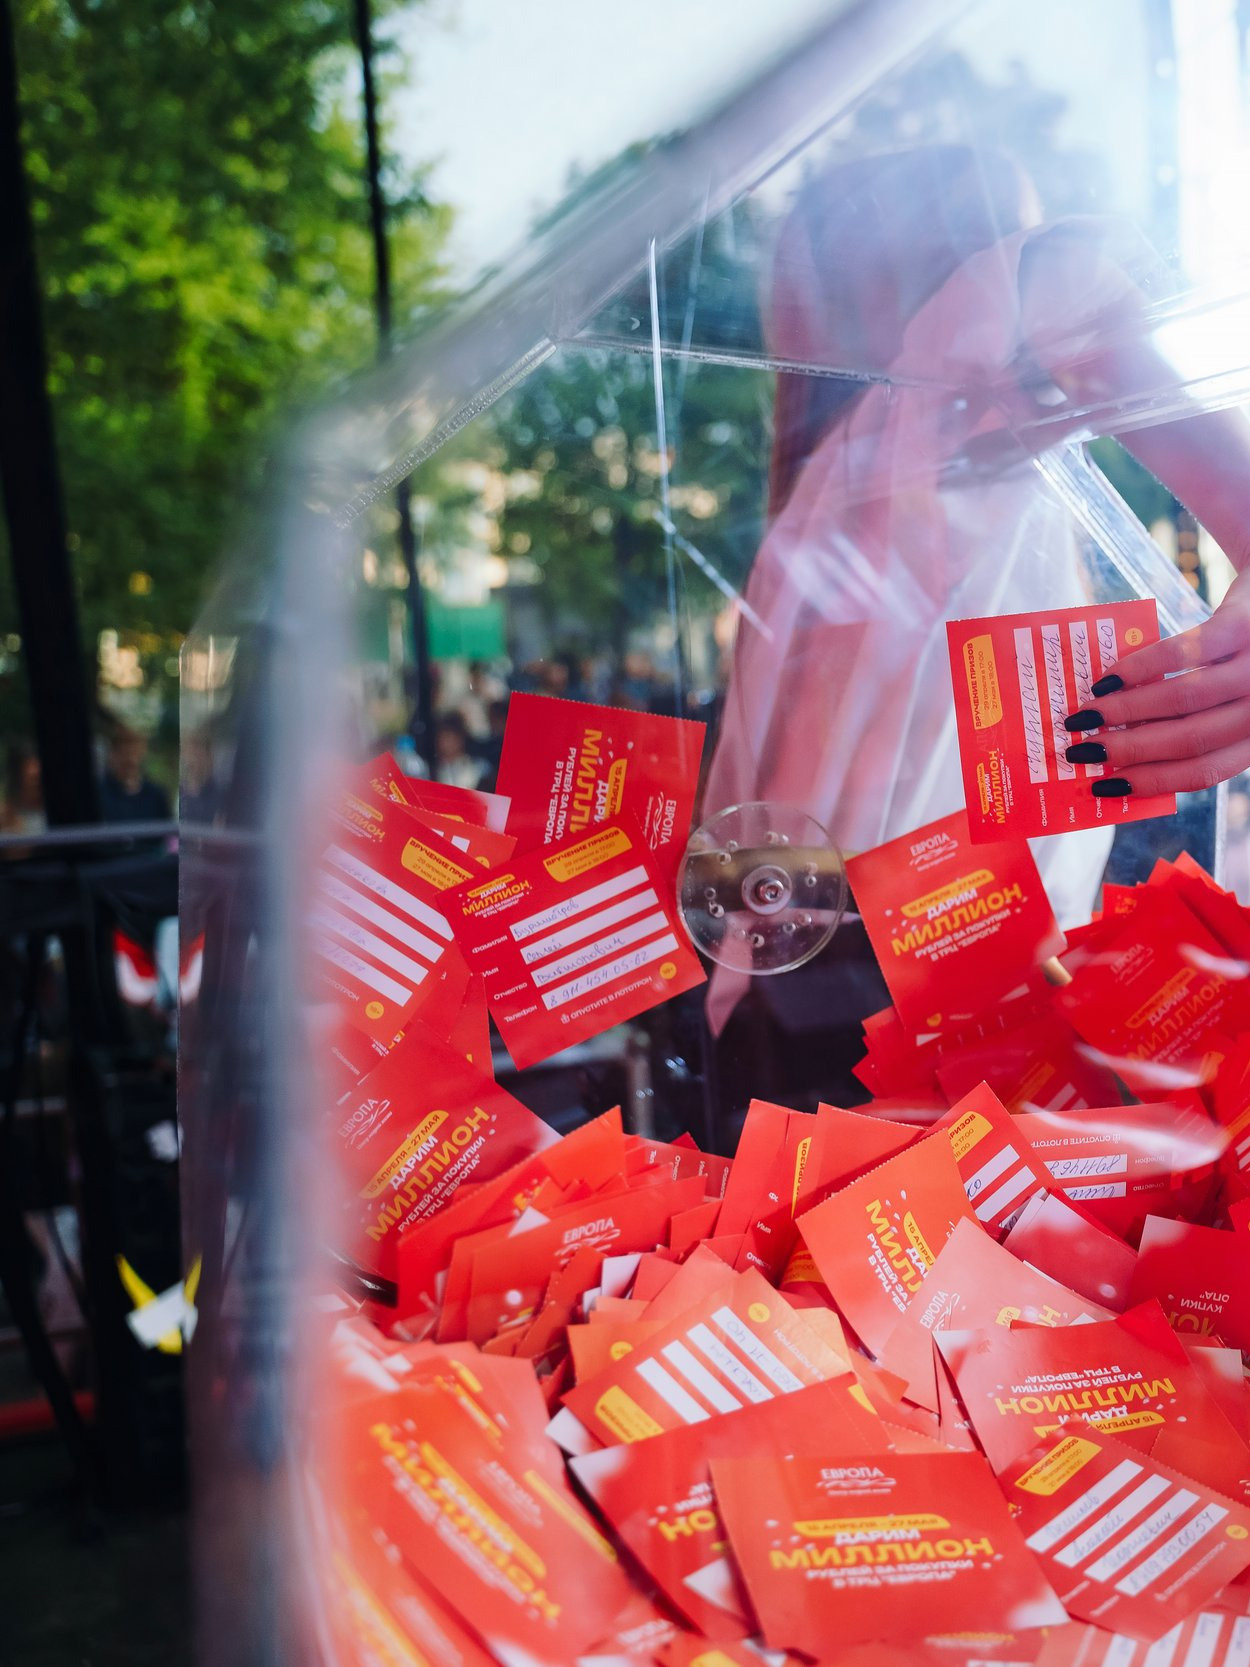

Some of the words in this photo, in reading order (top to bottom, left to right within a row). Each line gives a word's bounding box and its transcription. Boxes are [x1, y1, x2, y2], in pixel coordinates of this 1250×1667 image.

[966, 642, 976, 678] ПРИЗОВ
[970, 679, 983, 727] ВРУЧЕНИЕ
[550, 769, 562, 793] ТРЦ
[561, 746, 578, 792] РУБЛЕЙ
[559, 793, 569, 808] ЗА
[984, 773, 993, 802] ДАРИМ
[989, 750, 1006, 823] МИЛЛИОН
[658, 799, 677, 845] ЕВРОПА
[1037, 788, 1048, 826] Фамилия
[408, 838, 450, 869] ВРУЧЕНИЕ
[545, 843, 589, 867] ВРУЧЕНИЕ
[588, 828, 620, 847] ПРИЗОВ
[908, 830, 950, 857] ЕВРОПА
[461, 879, 530, 917] МИЛЛИОН
[923, 886, 979, 921] ДАРИМ
[889, 881, 1024, 957] МИЛЛИОН
[471, 933, 508, 956] Фамилия
[914, 934, 954, 958] РУБЛЕЙ
[929, 951, 939, 962] В
[937, 942, 959, 958] ТРЦ
[481, 965, 499, 979] Имя
[493, 980, 528, 1001] Отчество
[569, 995, 610, 1020] ОПУСТИТЕ
[612, 974, 653, 999] ЛОТОТРОН
[503, 1003, 538, 1024] Телефон
[1145, 986, 1193, 1026] ДАРИМ
[337, 1093, 379, 1140] ЕВРОПА
[946, 1113, 976, 1140] РИЗОВ
[375, 1148, 408, 1186] АПРЕЛЯ
[410, 1133, 422, 1147] 27
[419, 1112, 441, 1137] МАЯ
[1069, 1133, 1110, 1144] ОПУСТИТЕ
[363, 1101, 490, 1246] МИЛЛИОН
[387, 1132, 439, 1191] ДАРИМ
[396, 1191, 434, 1234] РУБЛЕЙ
[430, 1179, 446, 1196] ЗА
[441, 1133, 486, 1184] ПОКУПКИ
[423, 1197, 444, 1220] ТРЦ
[560, 1216, 616, 1244] ЕВРОПА
[865, 1232, 899, 1284] РУБЛЕЙ
[894, 1282, 908, 1301] ЗА
[866, 1254, 877, 1266] В
[872, 1264, 892, 1293] ТРЦ
[915, 1288, 954, 1329] ЕВРОПА
[1180, 1297, 1222, 1313] КУПКИ
[1072, 1378, 1089, 1388] ЗА
[1083, 1365, 1109, 1377] ТРЦ
[1091, 1370, 1142, 1386] РУБЛЕЙ
[1111, 1364, 1120, 1373] В
[994, 1373, 1176, 1420] МИЛЛИОН
[1010, 1377, 1071, 1396] ПОКУПКИ
[1095, 1416, 1140, 1431] АПРЕЛЯ
[820, 1464, 884, 1481] ЕВРОПА
[834, 1527, 920, 1545] ДАРИМ
[769, 1537, 993, 1571] МИЛЛИОН
